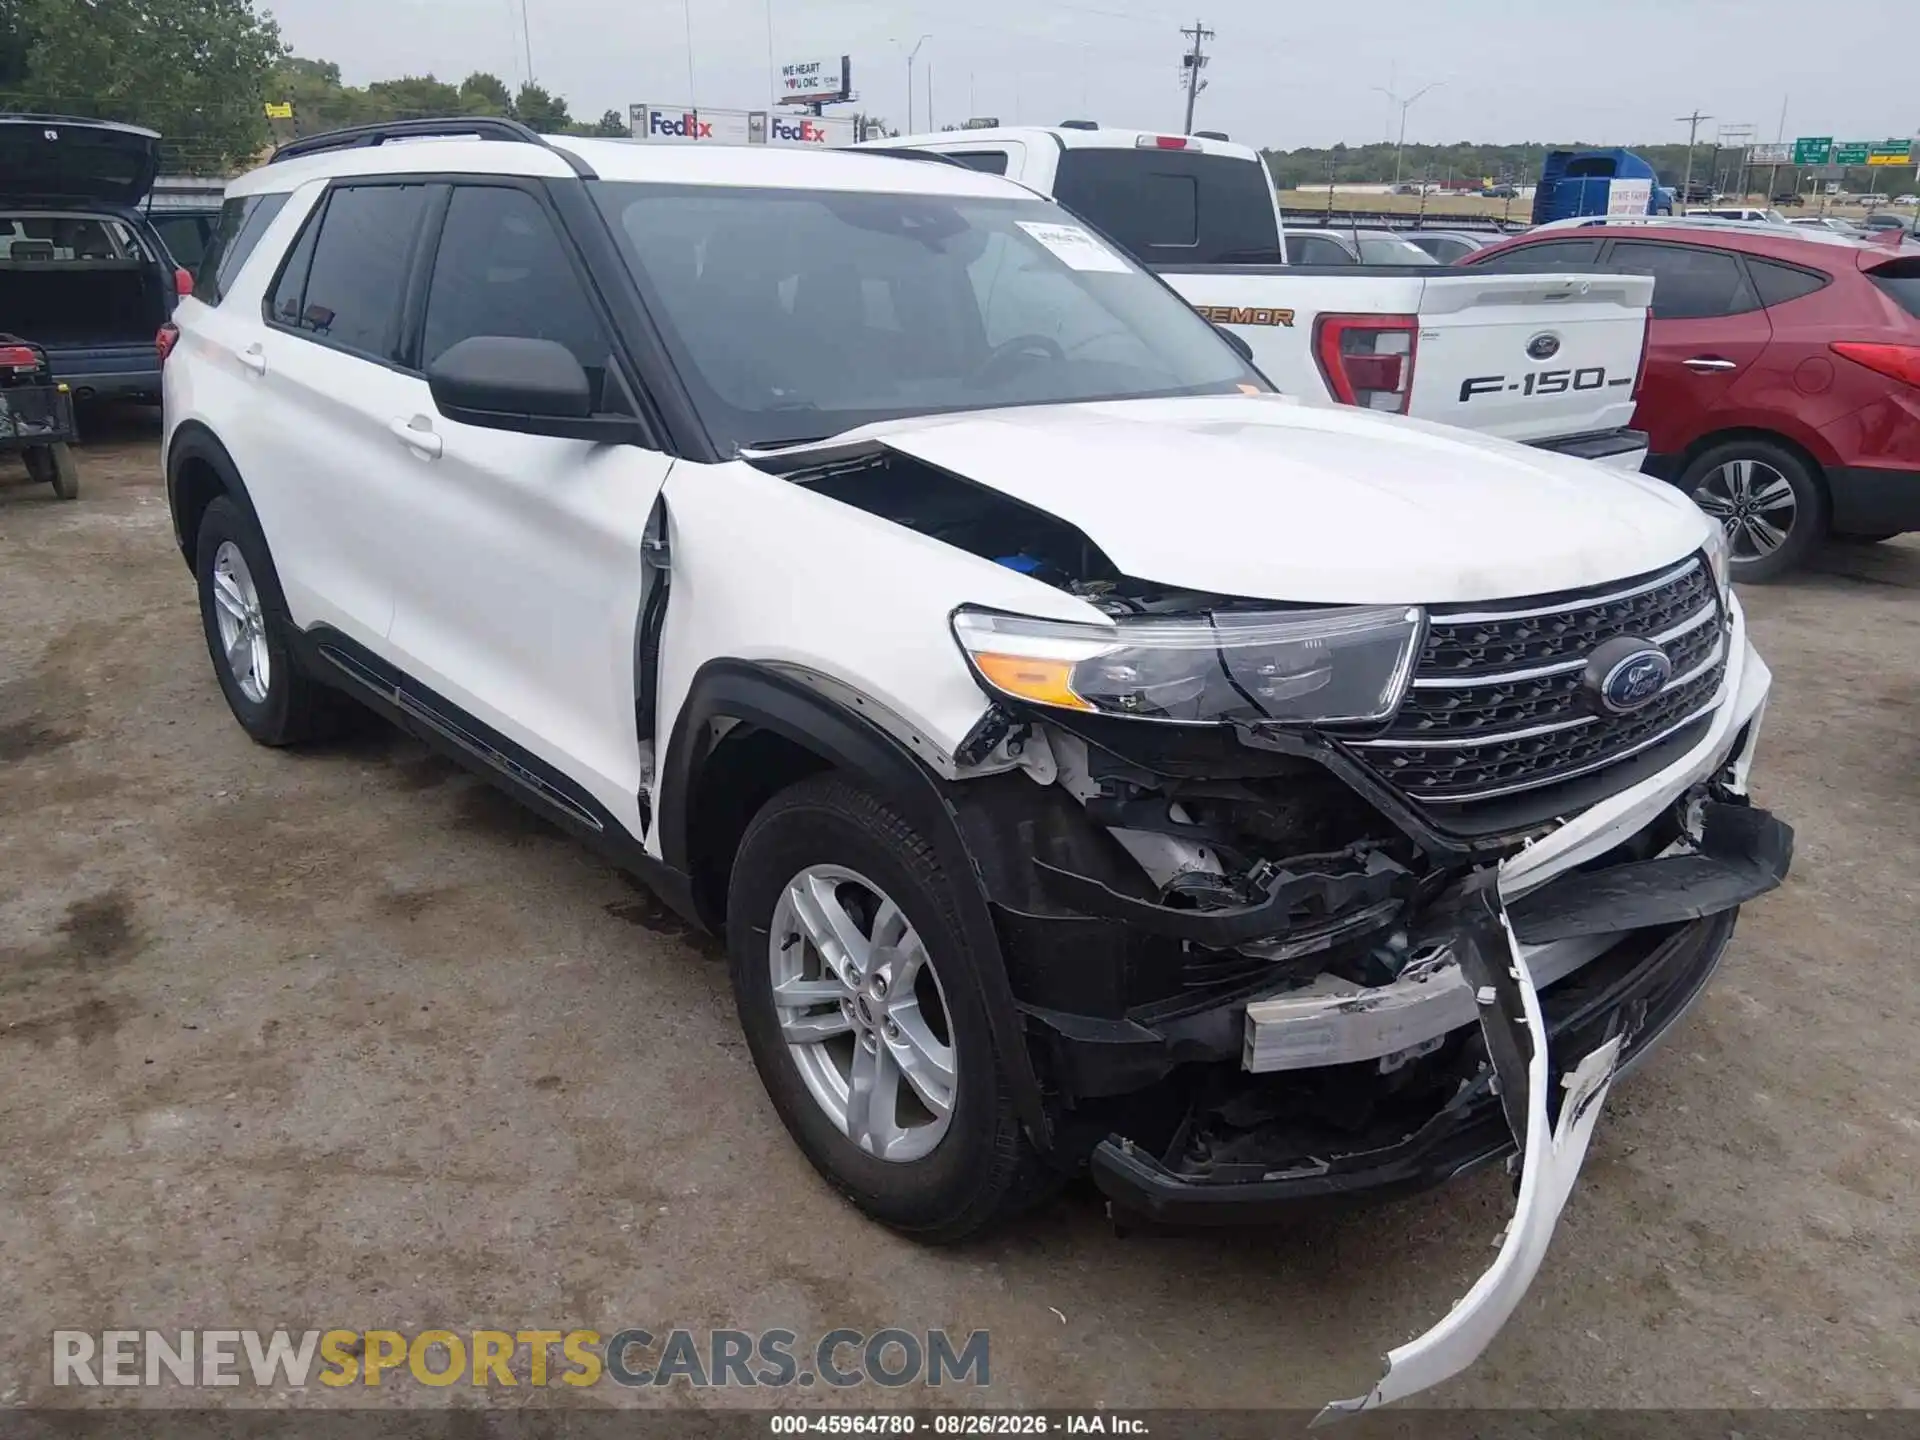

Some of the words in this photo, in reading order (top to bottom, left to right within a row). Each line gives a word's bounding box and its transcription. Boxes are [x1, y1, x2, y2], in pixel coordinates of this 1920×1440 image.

[782, 65, 795, 76] WE
[796, 63, 820, 75] HEART
[785, 78, 802, 89] YU
[650, 111, 713, 137] FedEx
[772, 118, 825, 143] FedEx
[1459, 367, 1606, 402] F-150
